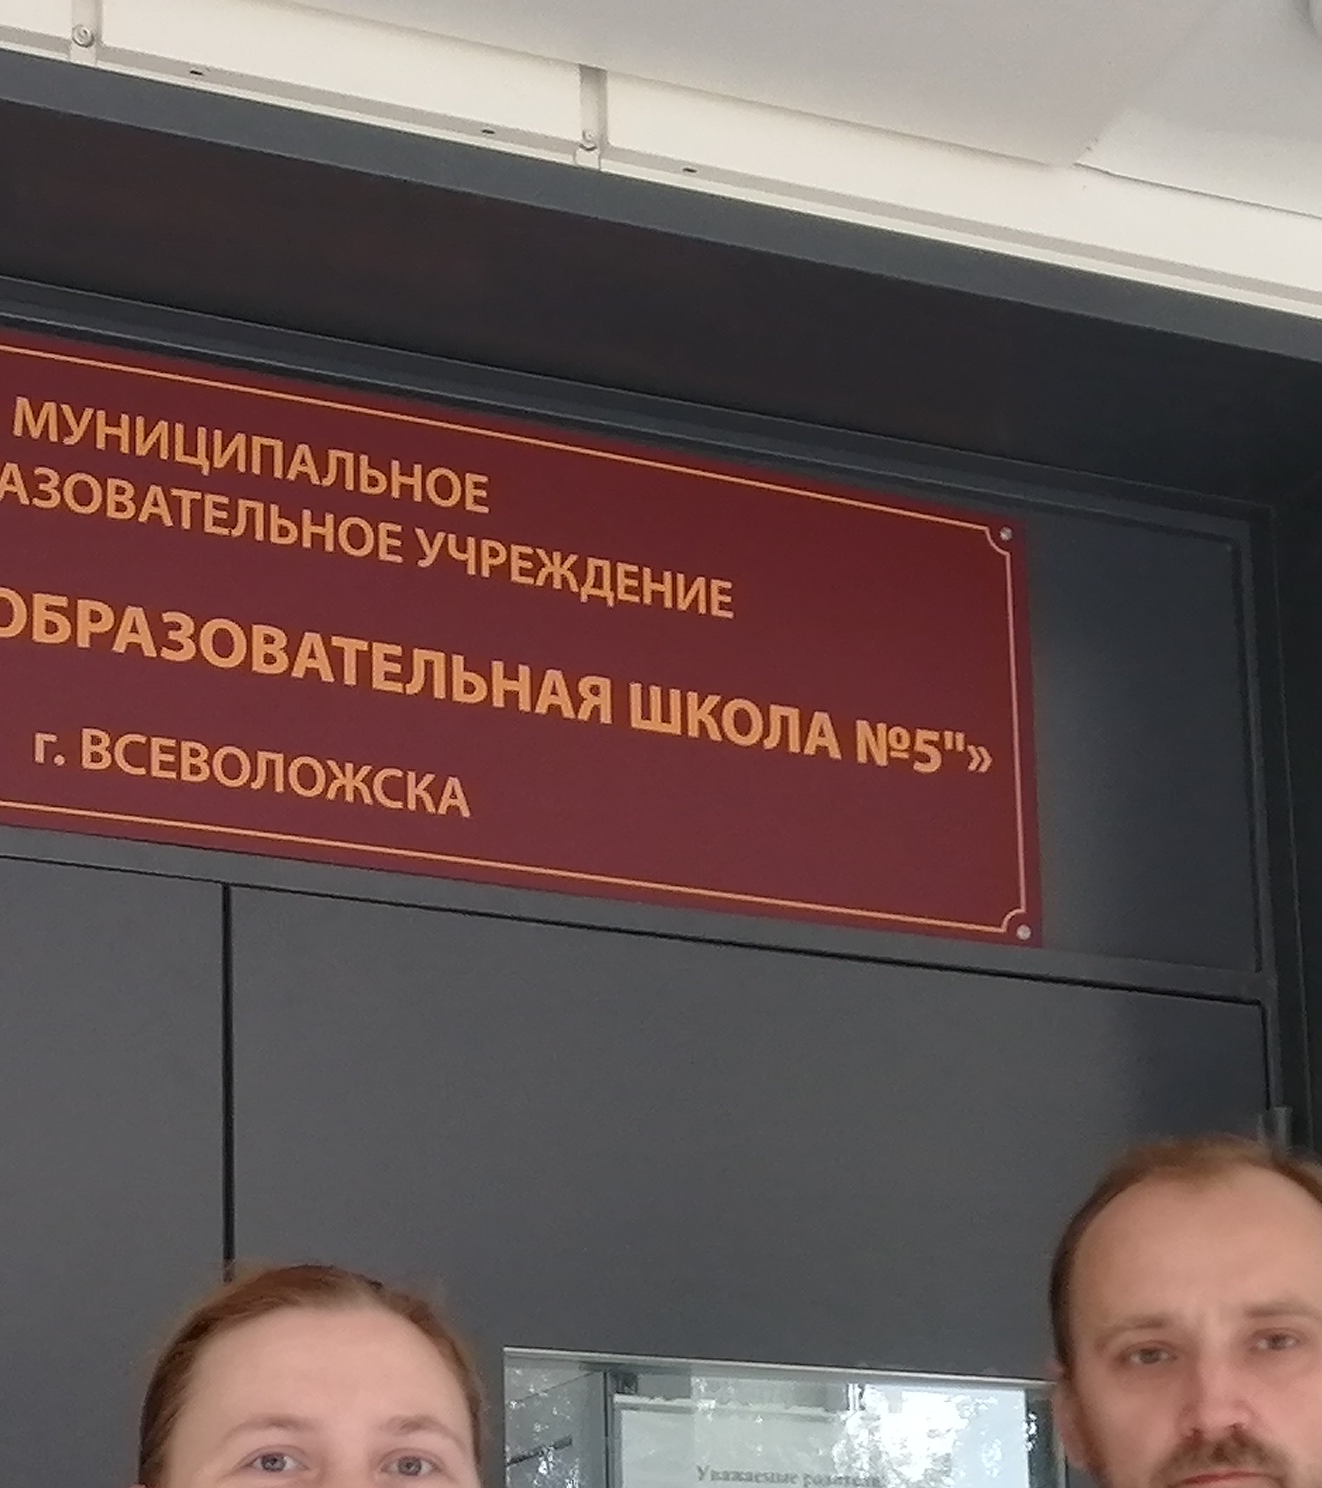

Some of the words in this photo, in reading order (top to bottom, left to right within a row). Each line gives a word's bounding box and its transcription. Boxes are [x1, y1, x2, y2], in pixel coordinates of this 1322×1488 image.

[12, 397, 490, 514] МУНИЦИПАЛЬНОЕ
[415, 528, 734, 619] УЧРЕЖДЕНИЕ
[630, 682, 842, 762] ШКОЛА
[34, 732, 65, 766] г.
[81, 729, 471, 818] ВСЕВОЛОЖСКА
